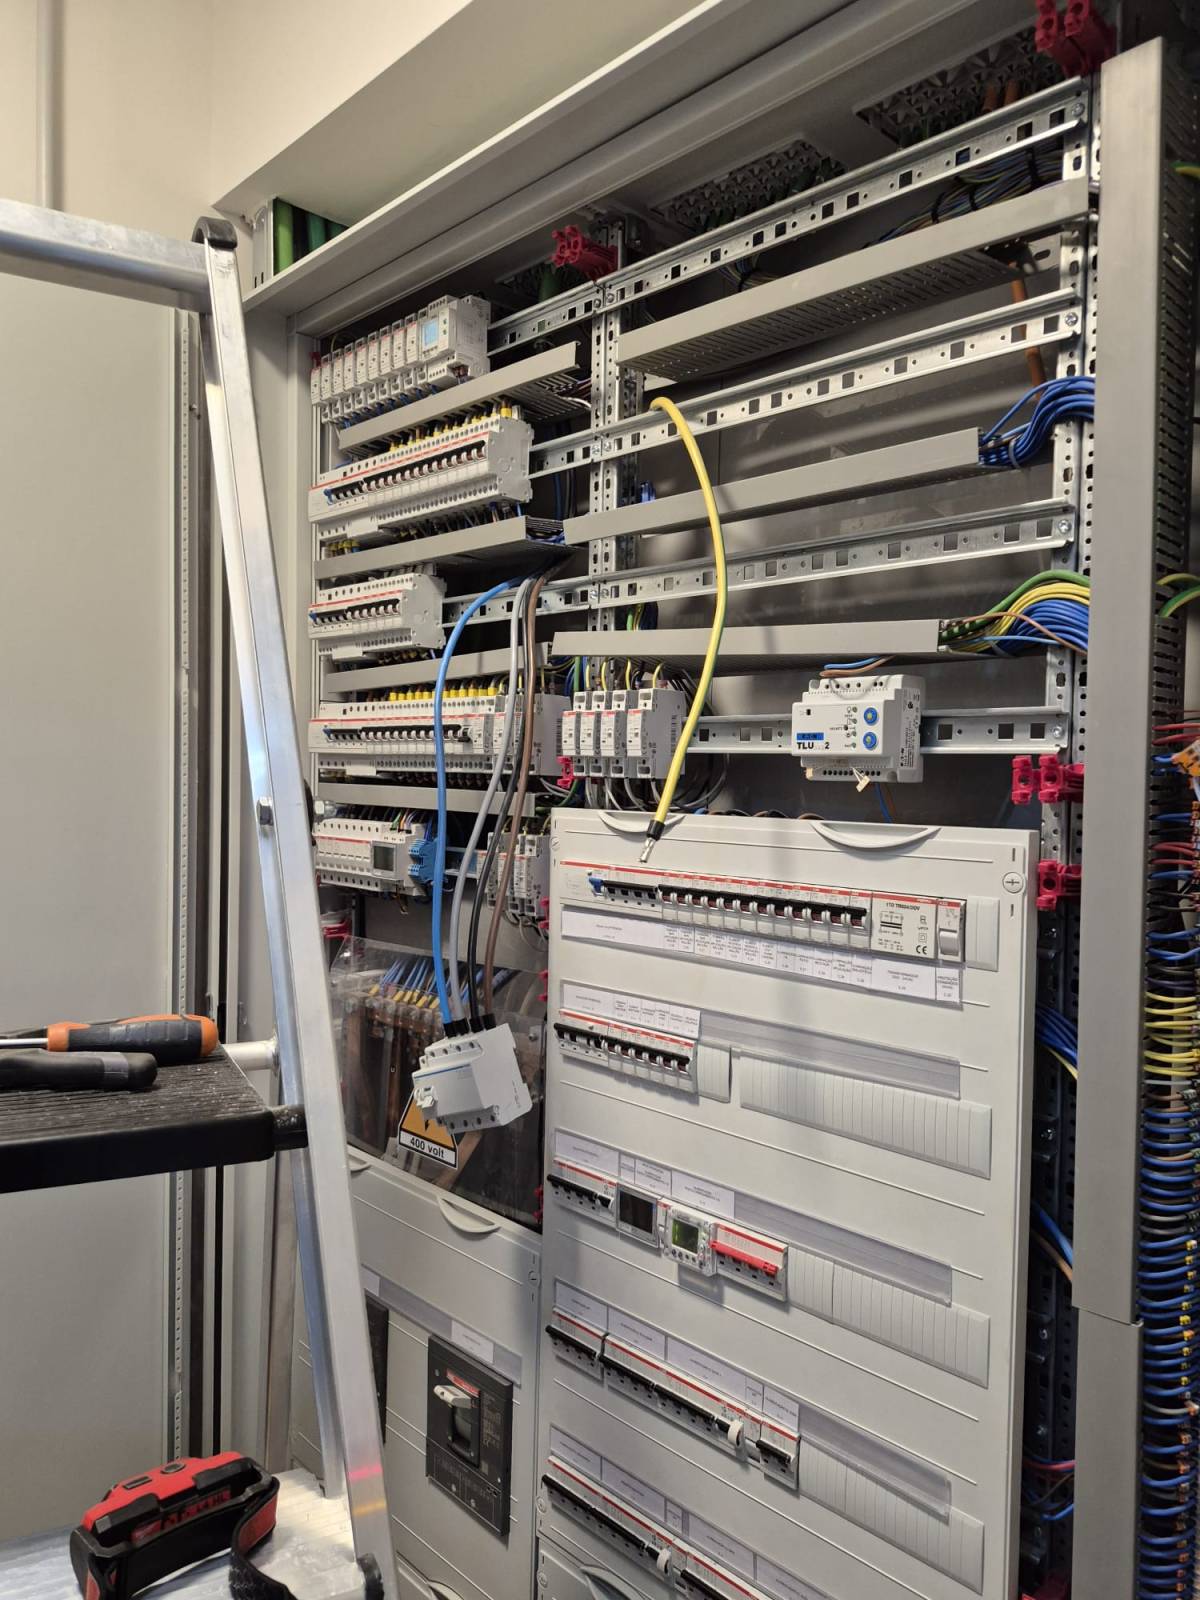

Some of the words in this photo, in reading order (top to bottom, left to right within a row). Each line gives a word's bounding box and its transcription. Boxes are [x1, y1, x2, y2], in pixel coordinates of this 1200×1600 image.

[797, 741, 814, 750] TLU
[825, 741, 830, 750] 2
[410, 1137, 425, 1150] 400
[428, 1144, 444, 1157] volt
